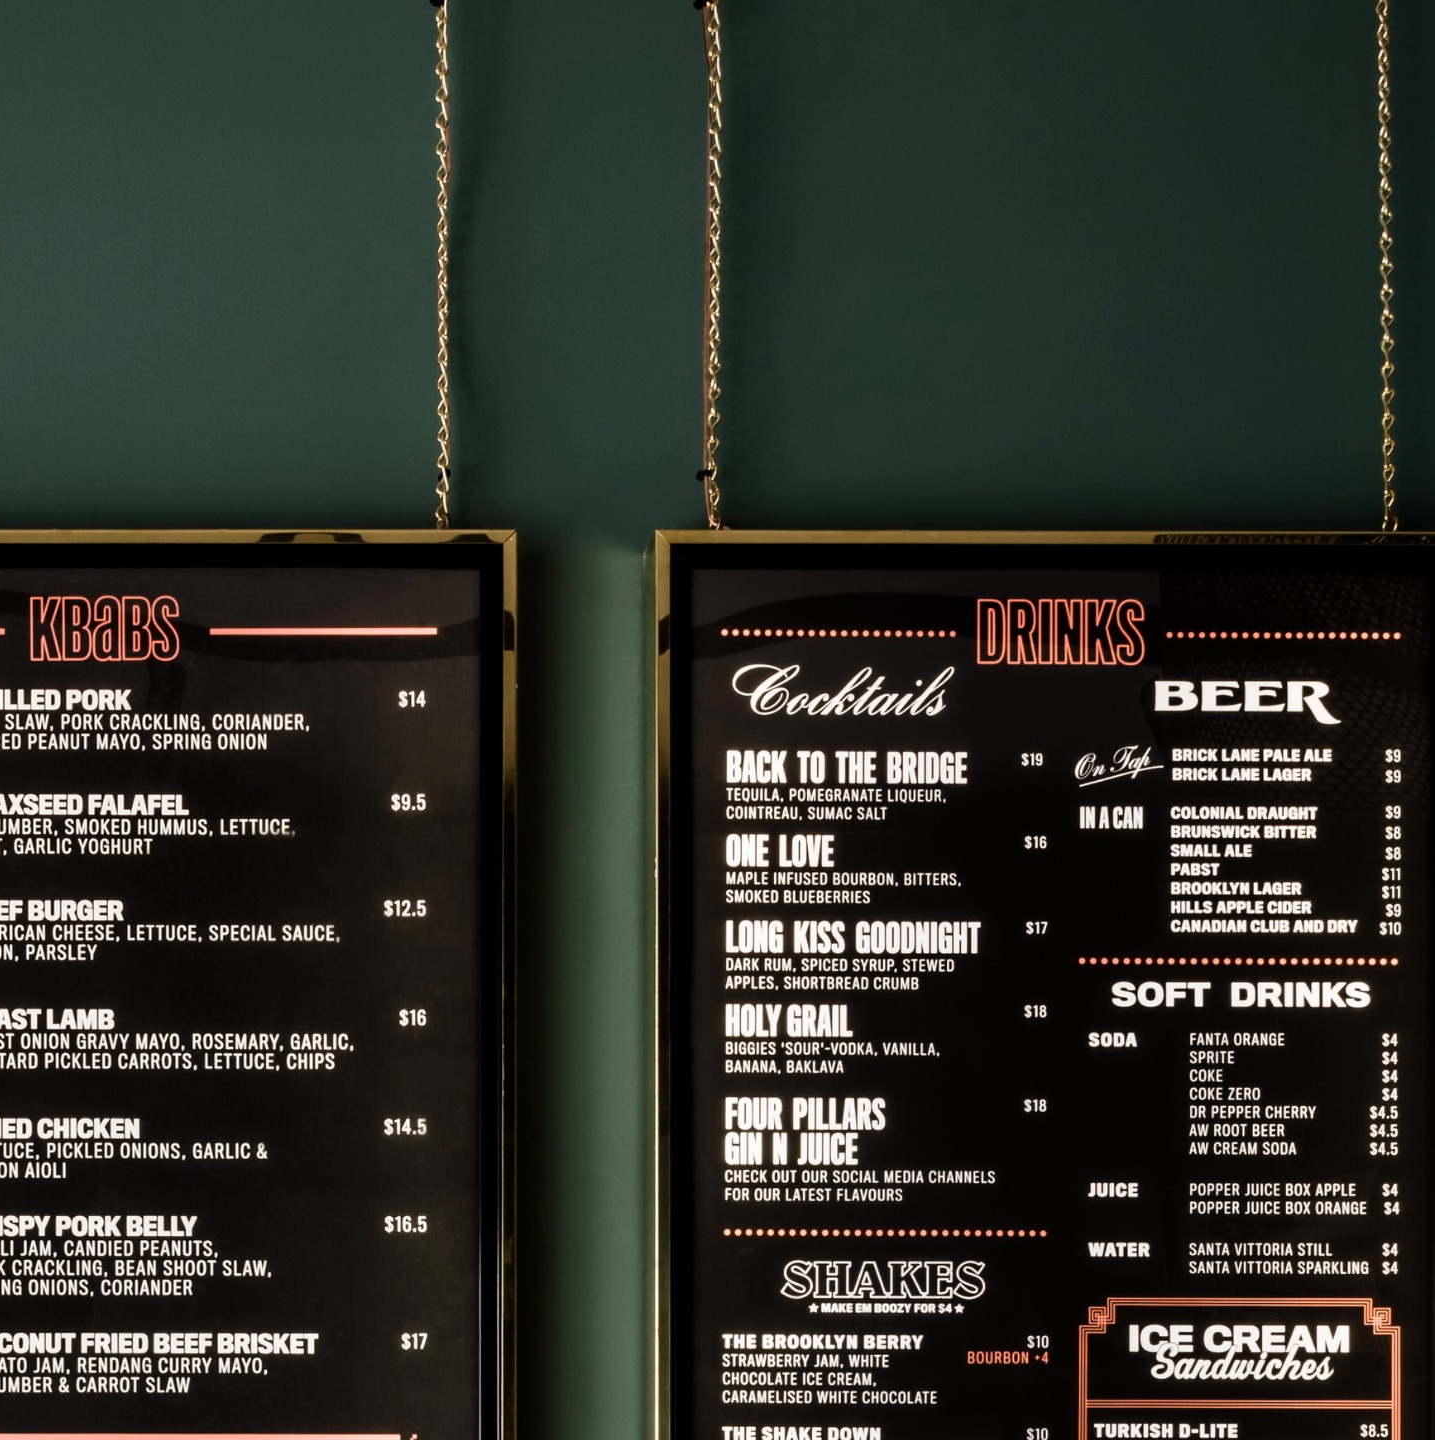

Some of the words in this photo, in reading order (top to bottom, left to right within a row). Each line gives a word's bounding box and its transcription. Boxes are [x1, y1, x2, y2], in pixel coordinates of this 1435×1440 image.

[976, 598, 1146, 667] DRINKS
[65, 688, 132, 711] PORK
[397, 689, 427, 709] $14
[731, 663, 955, 717] Cocktails
[1154, 680, 1342, 725] BEER
[2, 713, 55, 734] SLAW,
[60, 713, 104, 731] PORK
[109, 713, 206, 734] CRACKLING,
[211, 713, 310, 734] CORIANDER,
[725, 749, 788, 785] BACK
[796, 750, 826, 785] TO
[834, 750, 878, 785] THE
[886, 750, 968, 785] BRIDGE
[1020, 752, 1044, 767] $19
[1073, 751, 1107, 781] On
[1109, 743, 1153, 781] Tap
[1171, 748, 1219, 762] BRICK
[1221, 748, 1261, 763] LANE
[1262, 748, 1301, 763] PALE
[1303, 748, 1333, 763] ALE
[1384, 748, 1402, 763] $9
[87, 793, 190, 816] FALAFEL
[1170, 805, 1245, 820] COLONIAL
[1246, 805, 1319, 821] DRAUGHT
[1079, 805, 1096, 830] IN
[1098, 805, 1110, 830] A
[1112, 805, 1144, 830] CAN
[1170, 862, 1221, 877] PABST
[1381, 867, 1401, 882] $11
[27, 899, 125, 922] BURGER
[1111, 980, 1212, 1008] SOFT
[1230, 981, 1372, 1009] DRINKS
[46, 1008, 116, 1031] LAMB
[1088, 1031, 1138, 1048] SODA
[724, 1096, 783, 1131] FOUR
[792, 1096, 886, 1131] PILLARS
[1189, 1104, 1207, 1119] DR
[1211, 1105, 1261, 1119] PEPPER
[1264, 1105, 1317, 1120] CHERRY
[1369, 1105, 1399, 1120] $4.5
[36, 1117, 141, 1140] CHICKEN
[723, 1131, 764, 1166] GIN
[771, 1131, 788, 1166] N
[796, 1131, 859, 1166] JUICE
[1087, 1182, 1139, 1198] JUICE
[55, 1214, 122, 1238] PORK
[125, 1215, 198, 1237] BELLY
[1087, 1241, 1151, 1258] WATER
[779, 1259, 986, 1300] SHAKES
[820, 1302, 854, 1314] MAKE
[854, 1302, 873, 1314] EM
[873, 1302, 912, 1314] BOOZY
[913, 1302, 937, 1314] FOR
[937, 1302, 953, 1314] $4
[80, 1332, 149, 1355] FRIED
[152, 1332, 213, 1355] BEEF
[216, 1332, 320, 1355] BRISKET
[721, 1333, 758, 1350] THE
[761, 1333, 859, 1350] BROOKLYN
[863, 1334, 924, 1350] BERRY
[1128, 1323, 1194, 1354] ICE
[1203, 1324, 1351, 1354] CREAM
[1149, 1340, 1336, 1381] Sandwiches
[1093, 1422, 1174, 1439] TURKISH
[1178, 1423, 1239, 1439] D-LITE
[1359, 1423, 1389, 1438] $8.5
